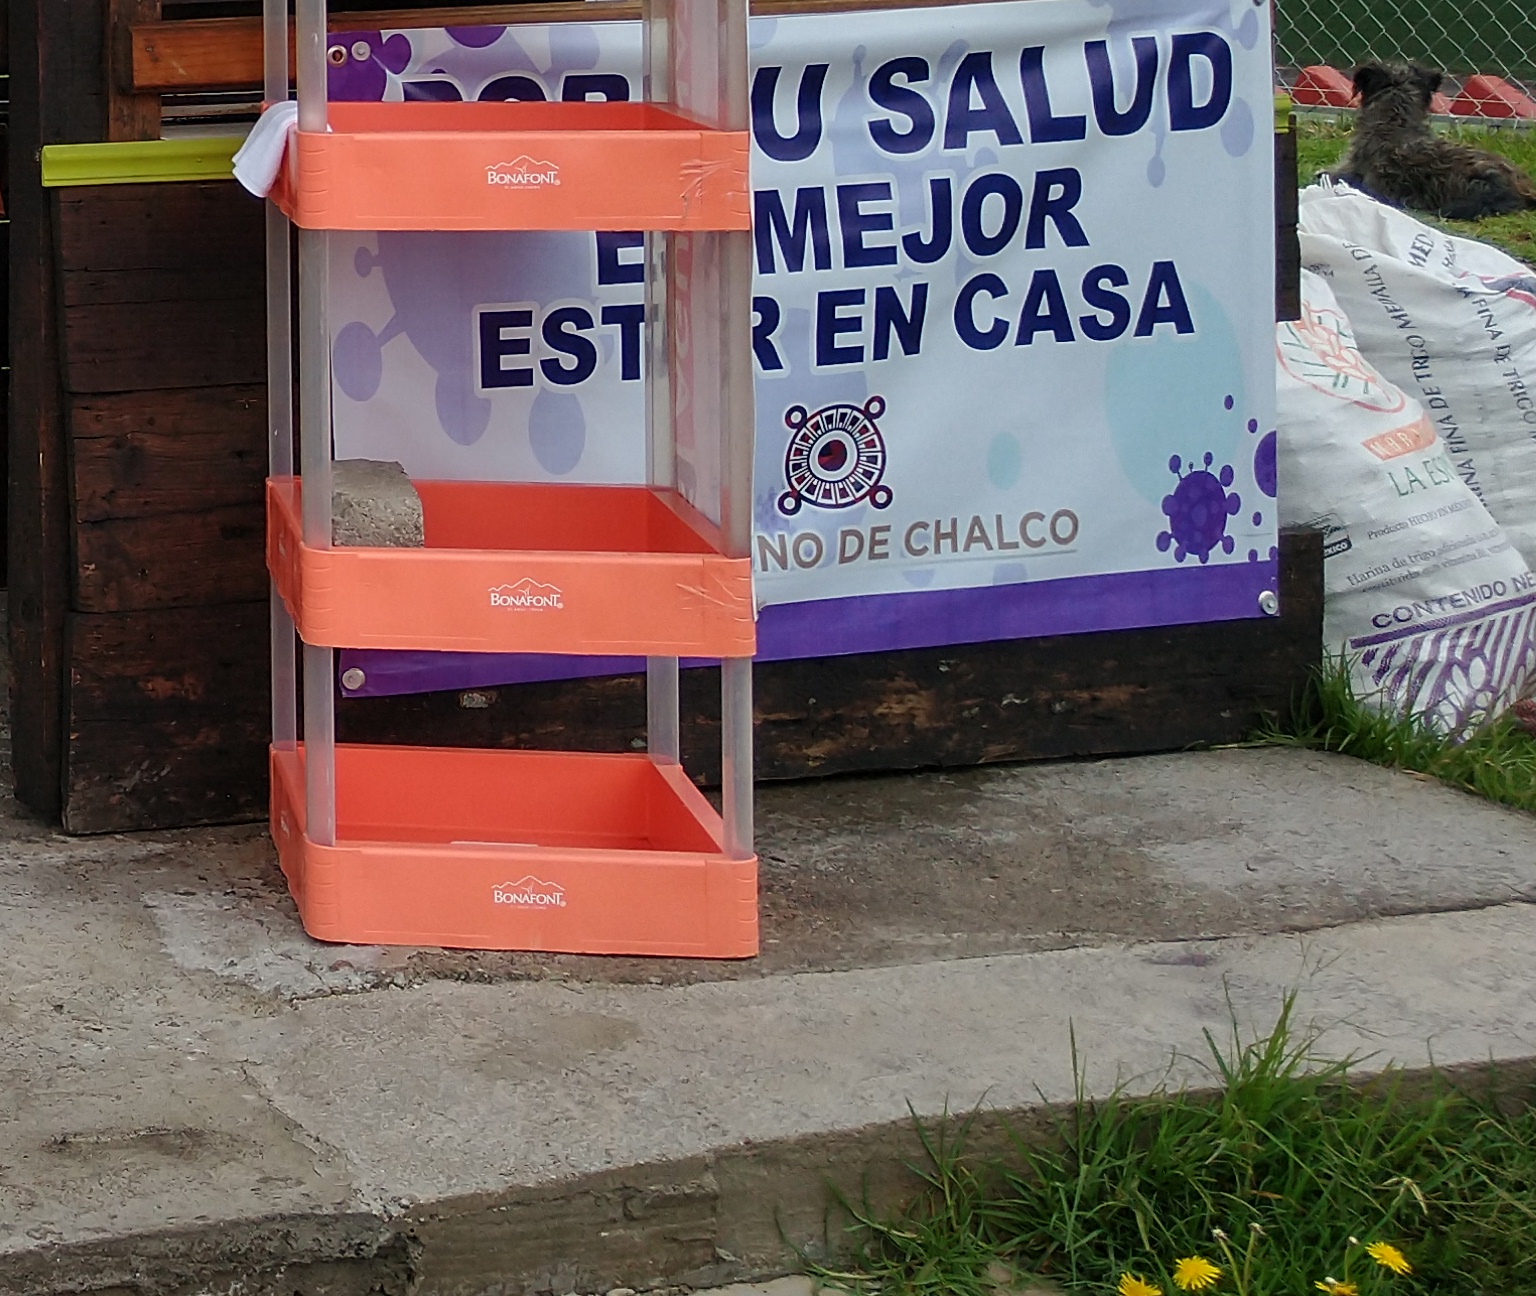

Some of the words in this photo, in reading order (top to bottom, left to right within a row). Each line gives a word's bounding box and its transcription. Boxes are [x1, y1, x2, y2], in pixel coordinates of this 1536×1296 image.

[867, 31, 1233, 155] SALUD
[486, 169, 559, 186] BONAFONT
[752, 167, 1091, 276] MEJOR
[479, 296, 784, 390] ESTR
[815, 282, 929, 367] EN
[952, 260, 1197, 351] CASA
[1422, 386, 1450, 411] DE
[1388, 466, 1427, 497] LA
[838, 524, 892, 565] DE
[904, 507, 1080, 558] CHALCO
[490, 593, 561, 607] BONAFONT
[1371, 580, 1508, 629] CONTENIDO
[494, 890, 564, 905] BONAFONT
